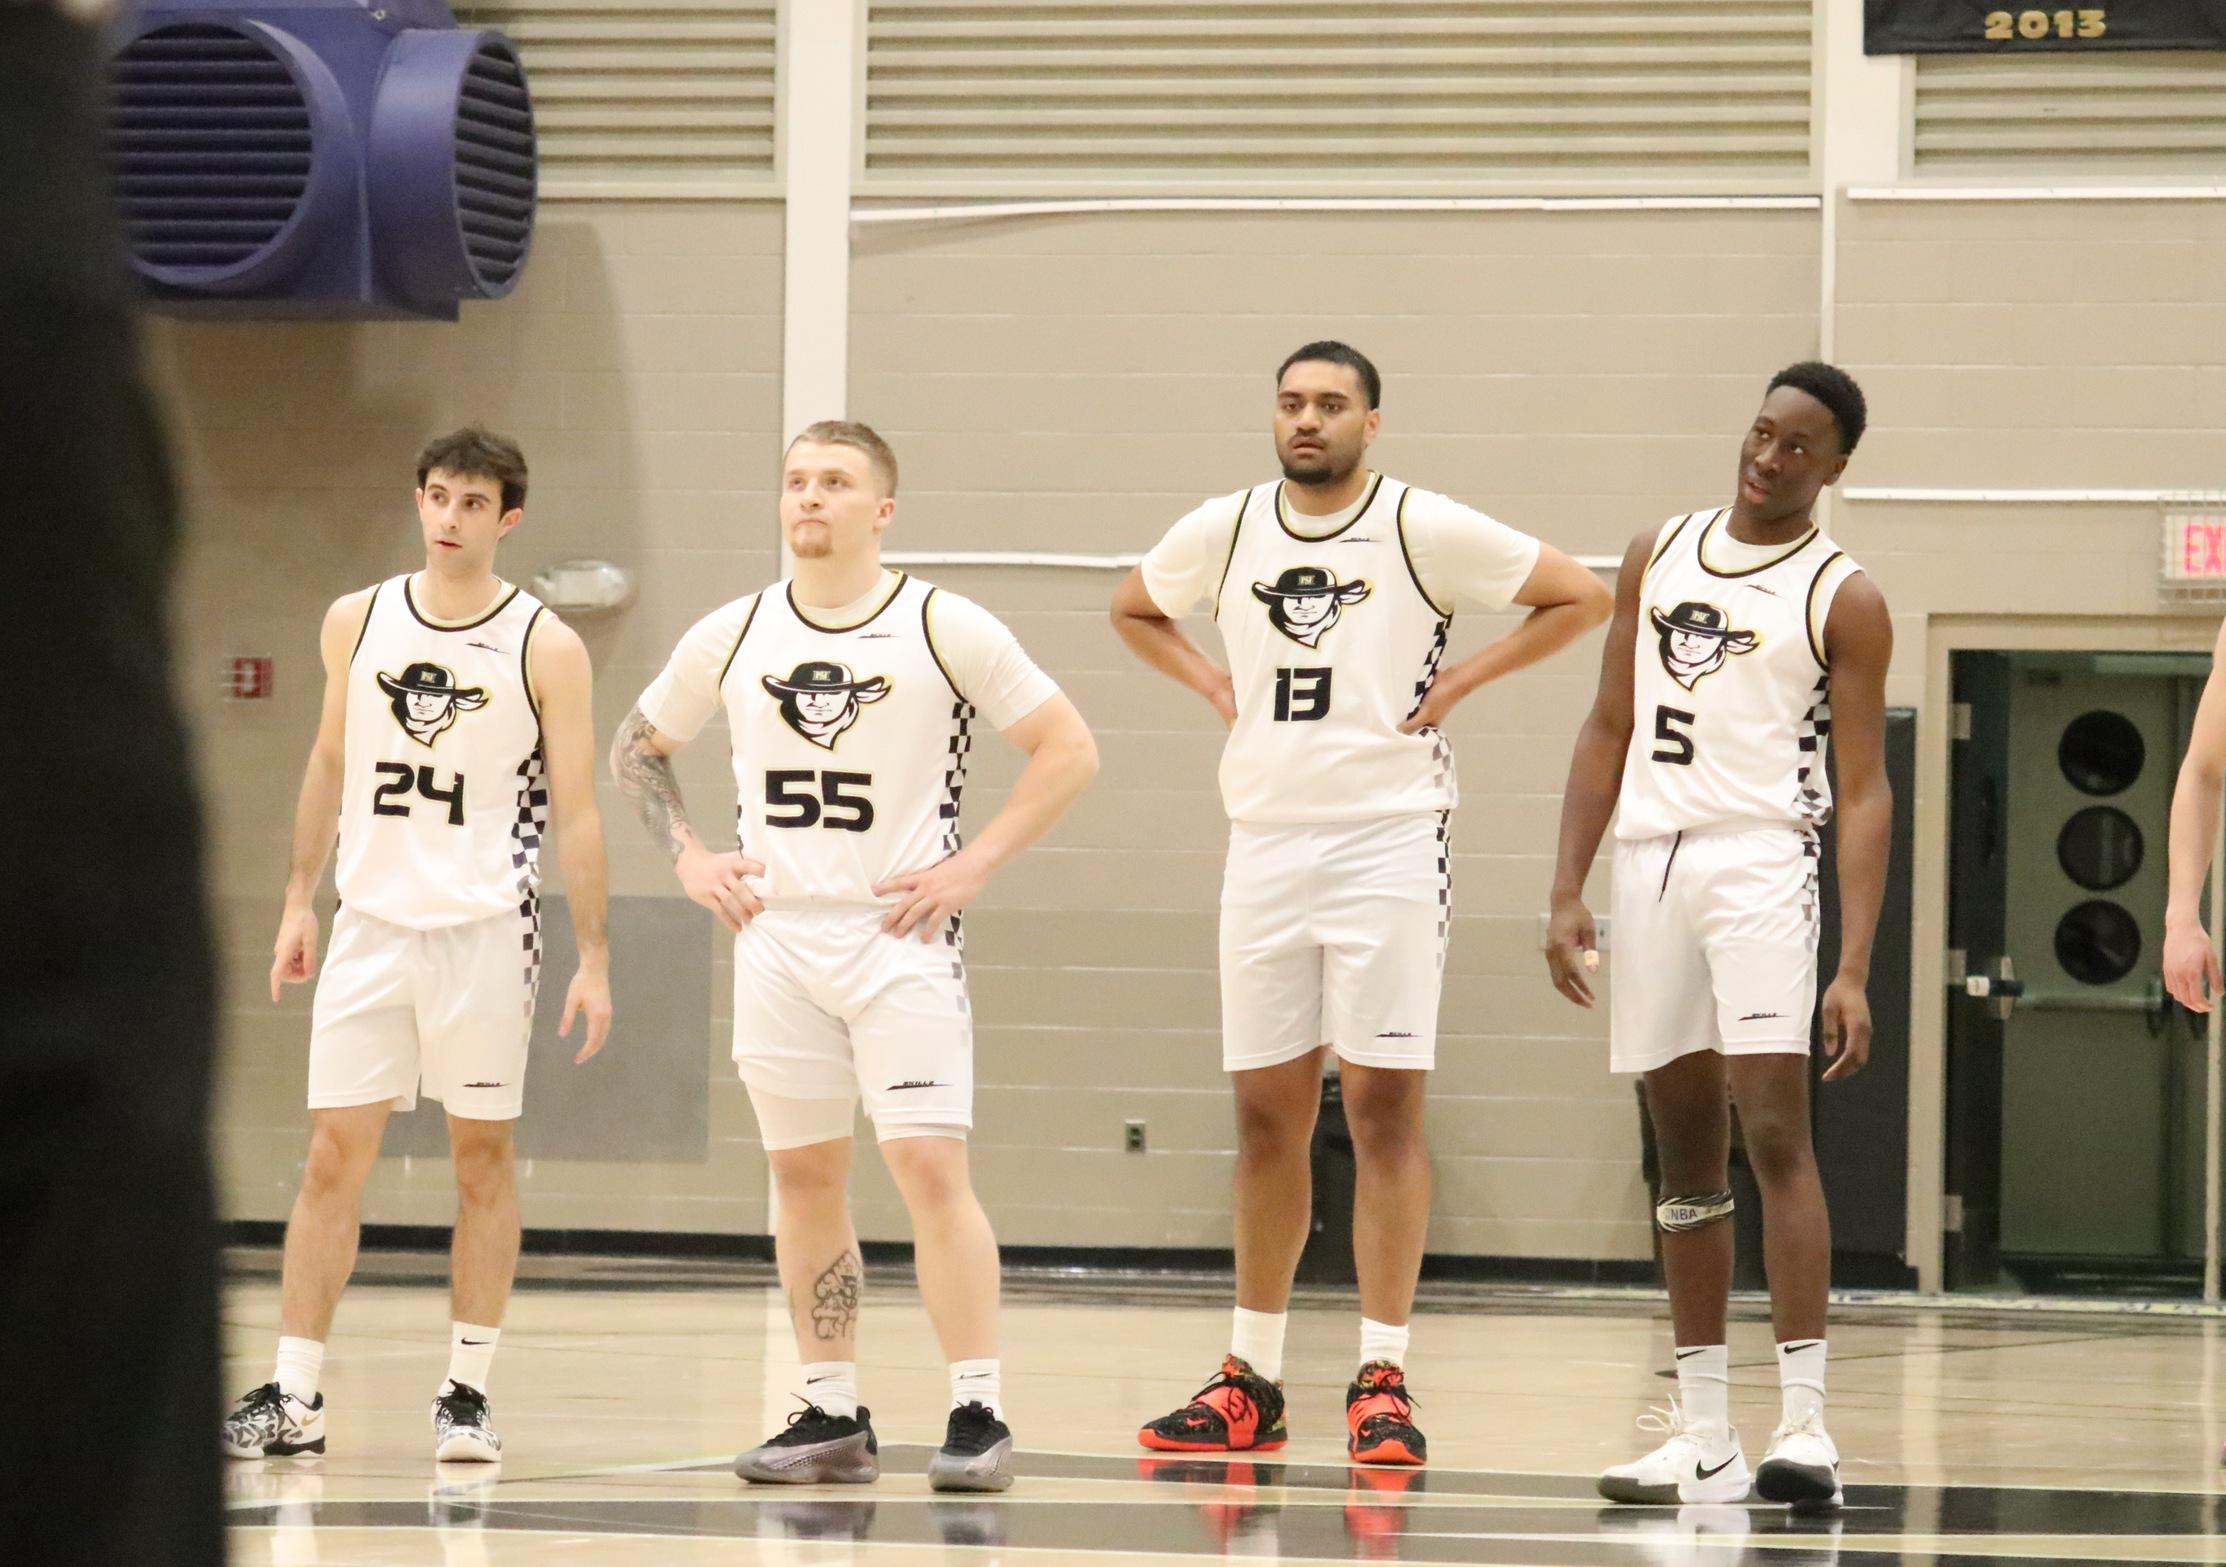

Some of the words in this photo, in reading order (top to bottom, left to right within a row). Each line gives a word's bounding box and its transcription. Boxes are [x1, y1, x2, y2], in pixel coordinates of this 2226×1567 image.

[1984, 9, 2107, 40] 2013
[2183, 524, 2226, 572] EX
[1273, 667, 1333, 722] 13
[1651, 704, 1696, 766] 5
[373, 761, 465, 826] 24
[765, 770, 874, 832] 55
[1671, 1208, 1698, 1221] NBA
